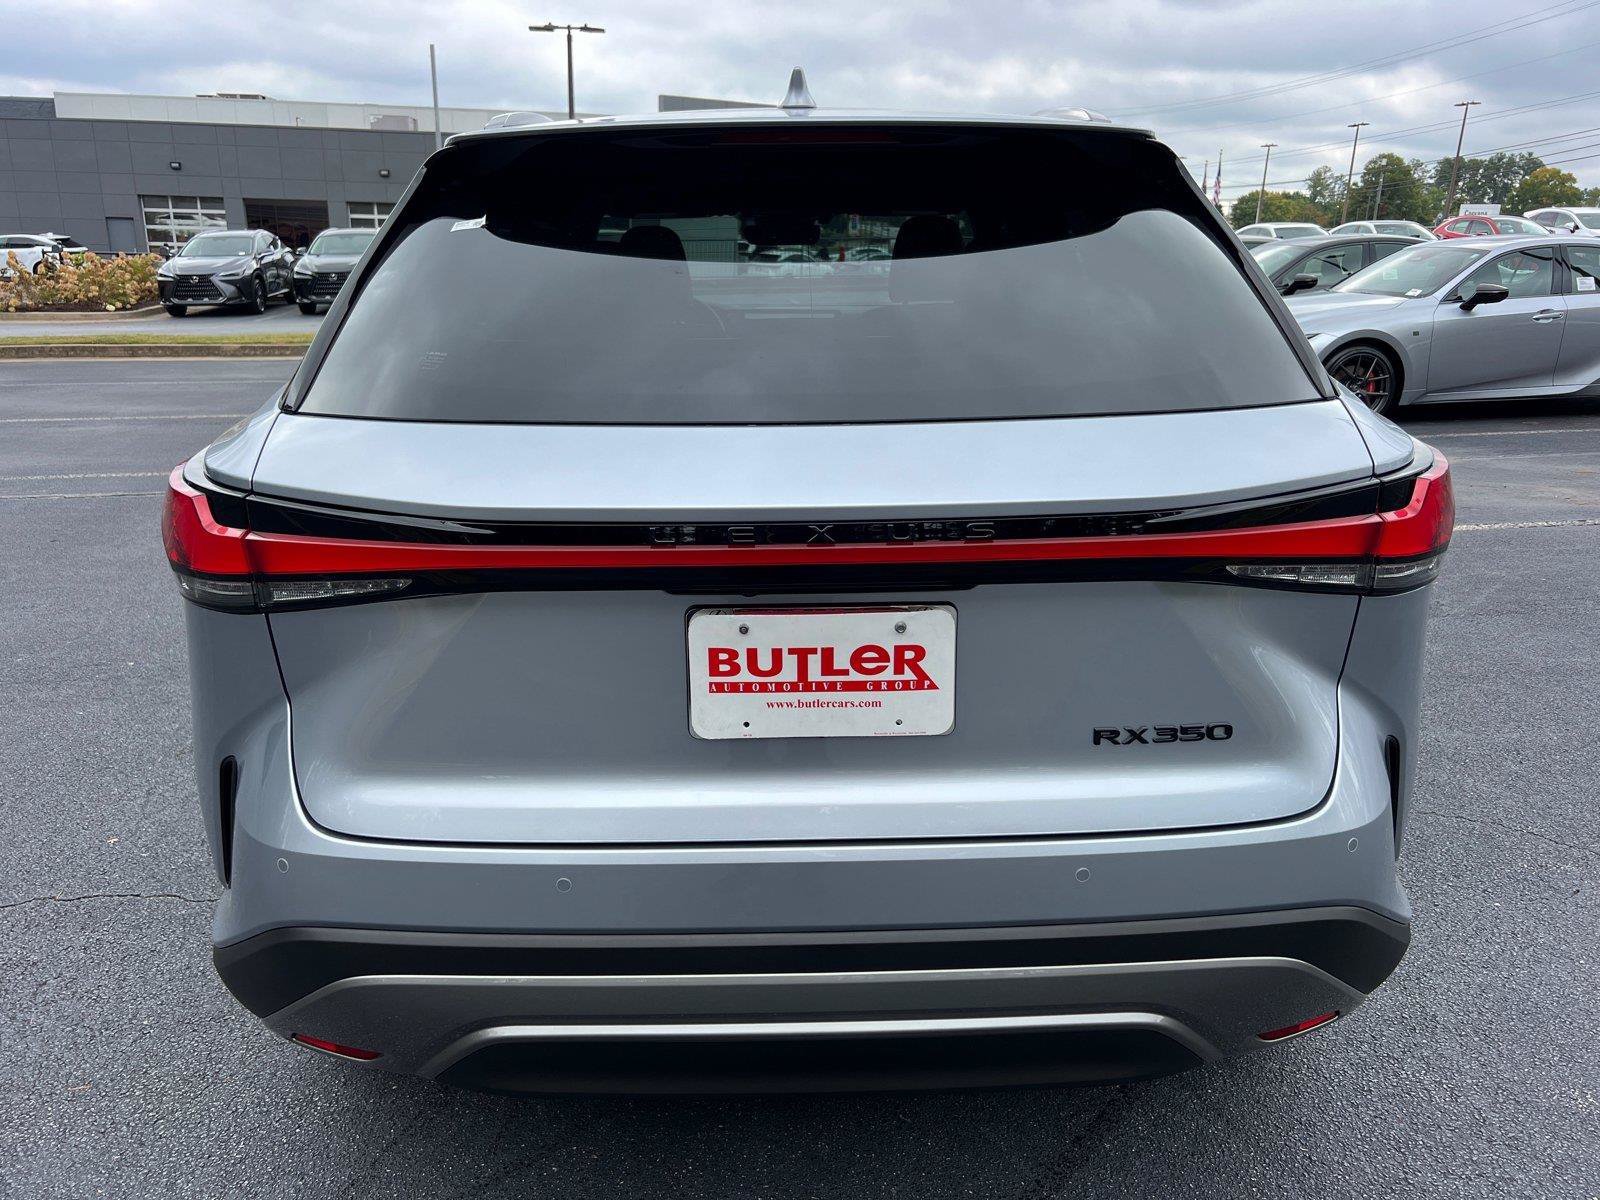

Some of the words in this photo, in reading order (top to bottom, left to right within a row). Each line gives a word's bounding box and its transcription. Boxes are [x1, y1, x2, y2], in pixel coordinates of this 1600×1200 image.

[649, 521, 996, 543] LEXUS
[709, 681, 844, 693] AUTOMOTIVE
[866, 679, 932, 691] GROUP
[766, 698, 882, 709] www.butlercars.com
